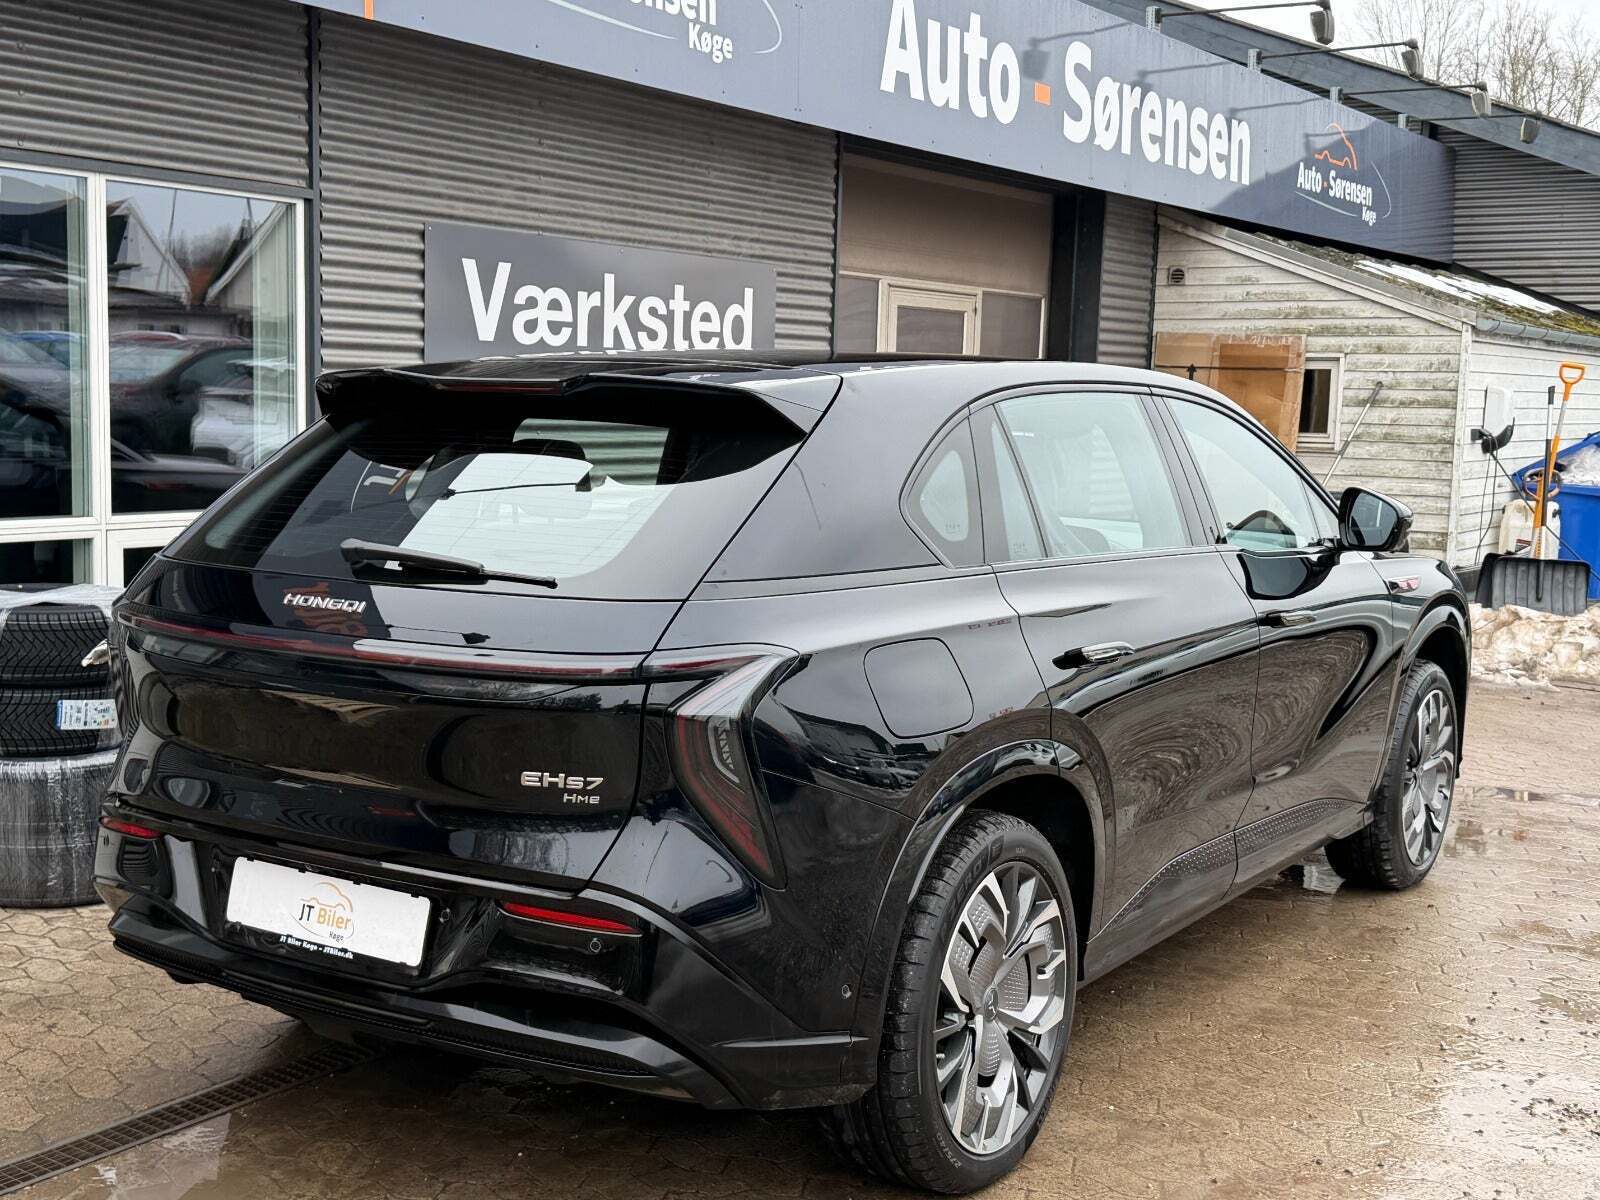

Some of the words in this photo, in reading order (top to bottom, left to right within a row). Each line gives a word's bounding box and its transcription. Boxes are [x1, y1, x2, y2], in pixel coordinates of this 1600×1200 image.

[688, 21, 733, 64] Køge
[879, 0, 1020, 125] Auto
[1062, 40, 1251, 186] Sørensen
[1297, 162, 1322, 193] Auto
[1329, 170, 1372, 206] Sørensen
[1362, 207, 1376, 226] Køge
[462, 257, 754, 350] Værksted
[282, 592, 366, 614] HONGQI
[300, 904, 315, 921] JT
[317, 909, 351, 929] Biler
